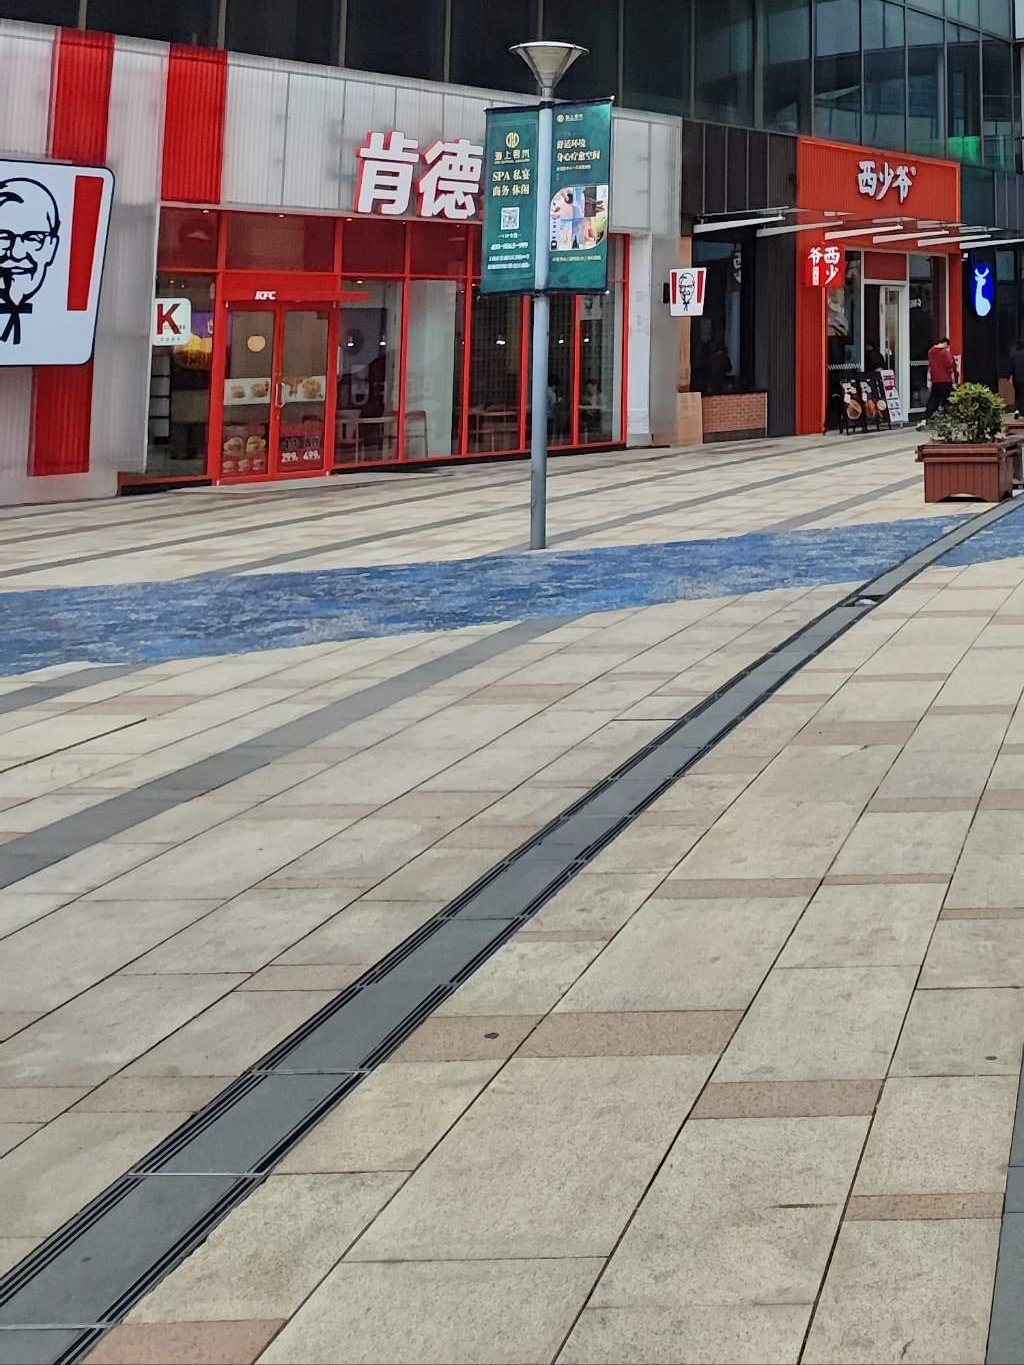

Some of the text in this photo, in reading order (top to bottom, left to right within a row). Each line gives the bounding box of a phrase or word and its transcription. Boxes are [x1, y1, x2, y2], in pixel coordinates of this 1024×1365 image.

[355, 131, 485, 219] 肯德
[492, 170, 511, 182] SPA
[857, 160, 917, 204] 西少爷
[492, 183, 530, 197] 商务 休闲
[254, 290, 277, 301] KFC
